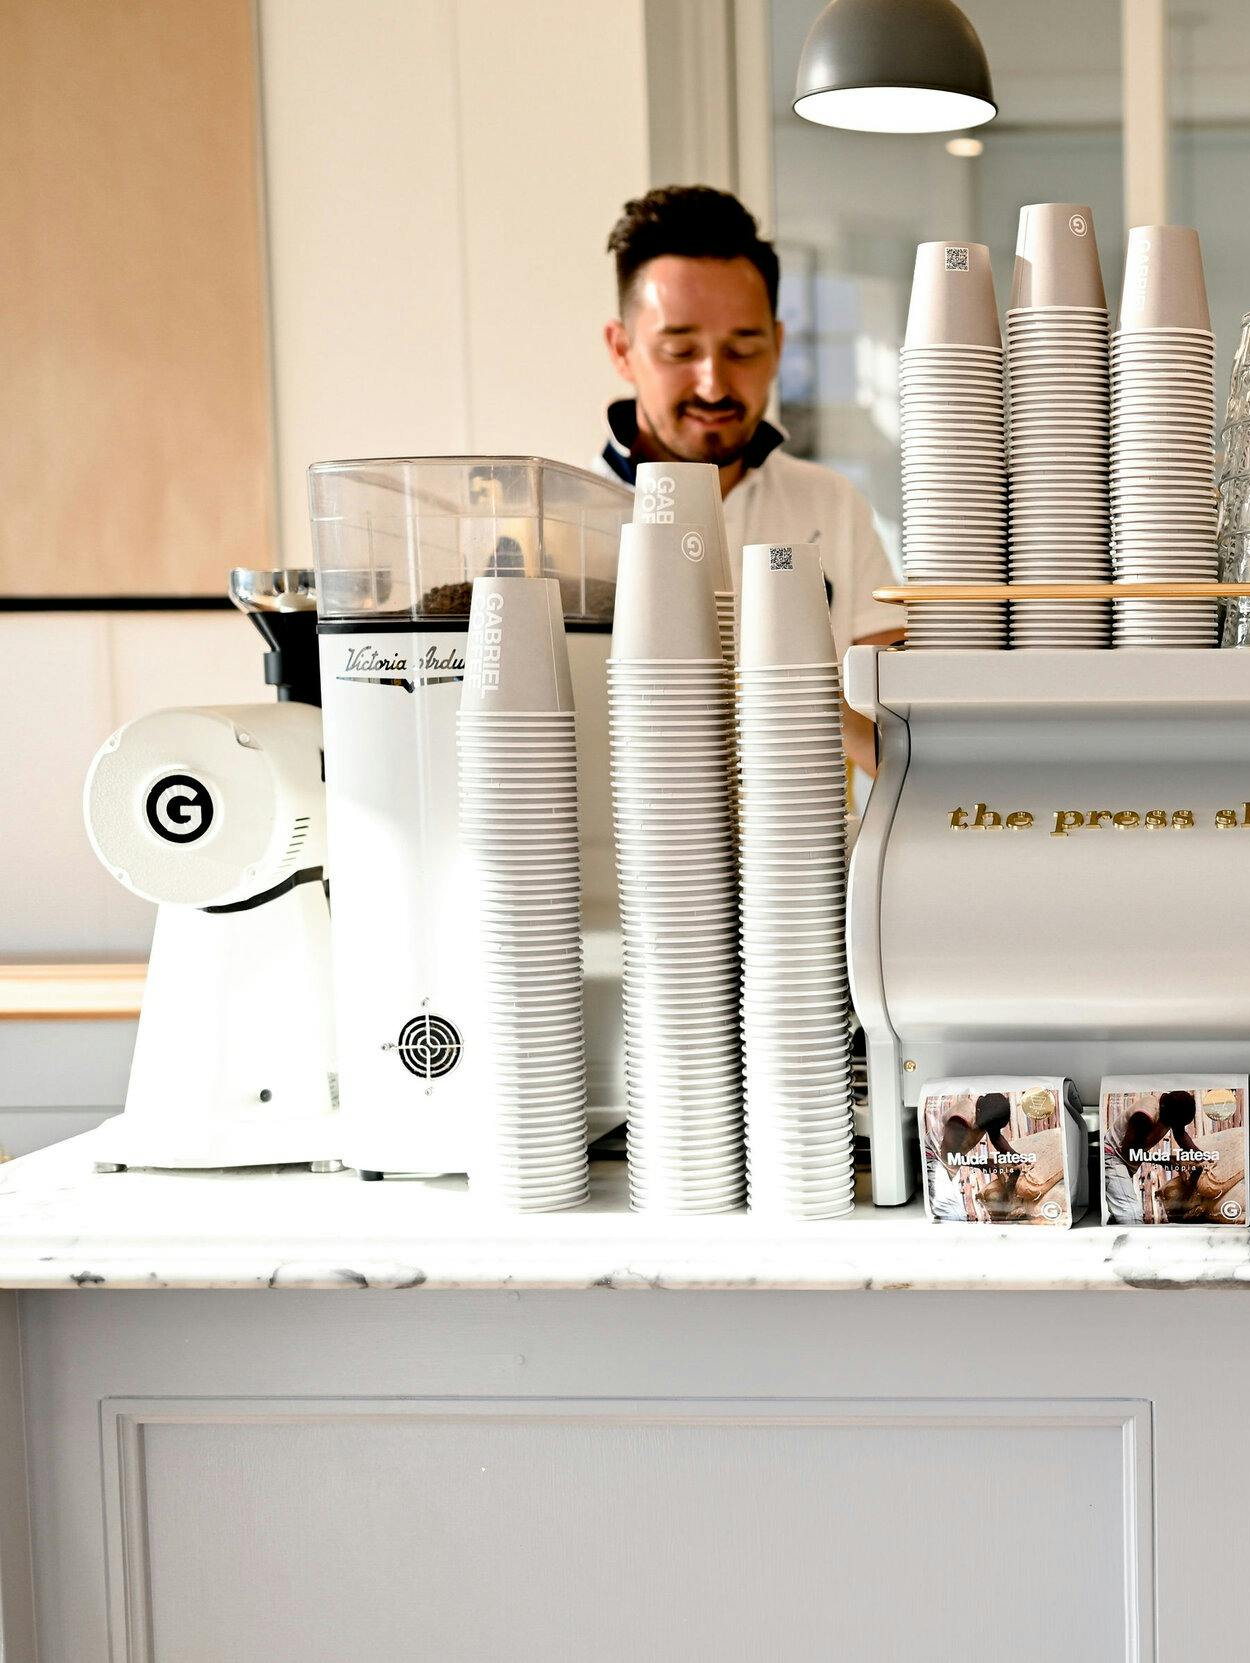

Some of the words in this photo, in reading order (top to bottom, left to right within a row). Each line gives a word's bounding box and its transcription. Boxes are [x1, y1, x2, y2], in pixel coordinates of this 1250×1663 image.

[345, 645, 407, 671] Victoria
[480, 592, 504, 699] GABRIEL
[153, 782, 205, 837] G
[948, 803, 1034, 830] the
[1049, 807, 1195, 837] press
[947, 1152, 988, 1165] Muda
[992, 1151, 1037, 1164] Tatesa
[1129, 1149, 1170, 1161] Muda
[1172, 1149, 1219, 1161] Tatesa
